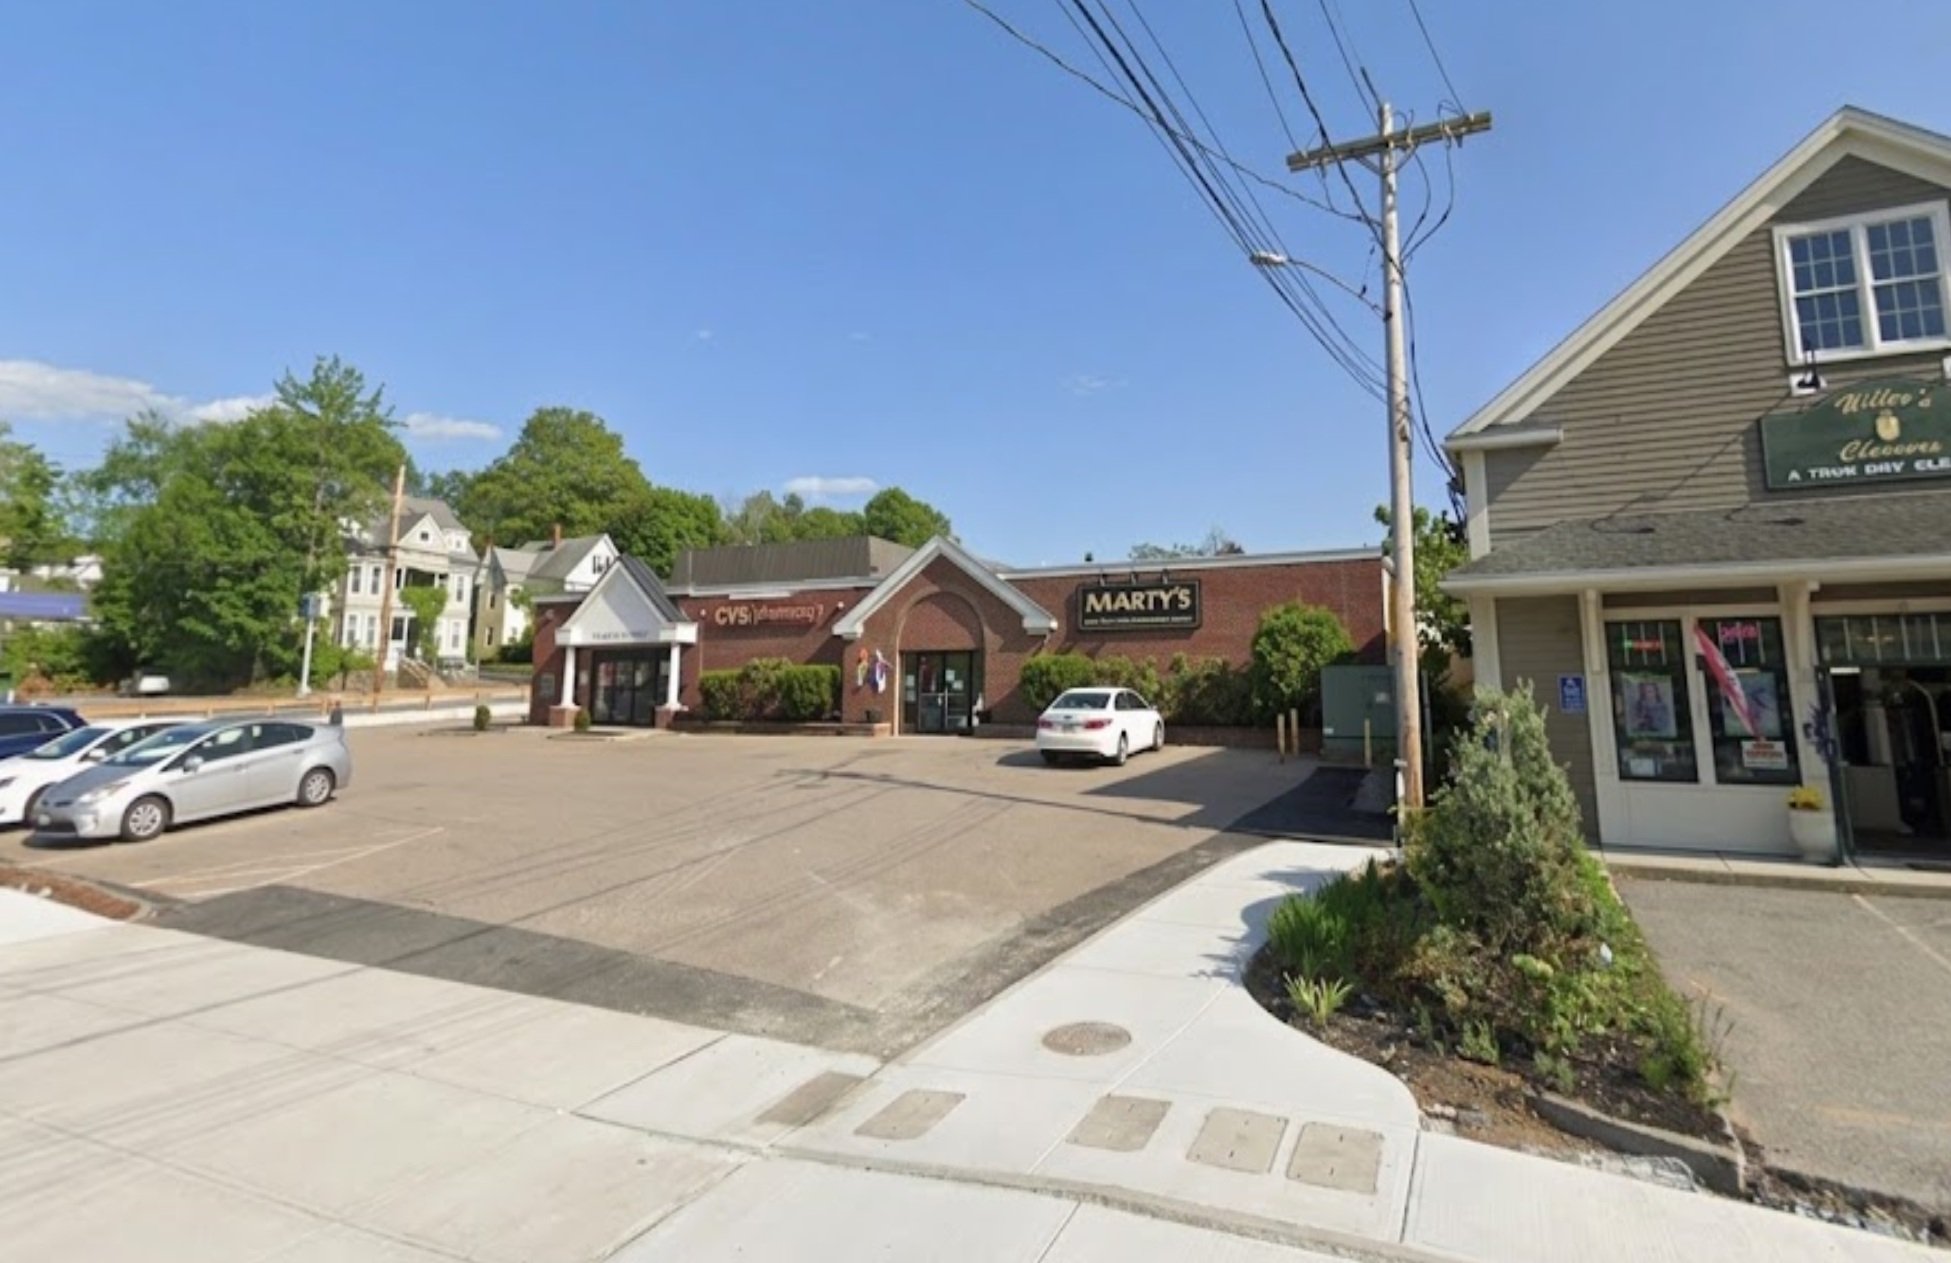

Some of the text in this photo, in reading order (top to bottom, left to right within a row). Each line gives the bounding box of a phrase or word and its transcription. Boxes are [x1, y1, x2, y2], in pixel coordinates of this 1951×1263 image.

[1787, 469, 1802, 481] A
[1863, 461, 1905, 475] DRY
[1085, 586, 1192, 613] MARTY'S
[715, 605, 749, 626] CVS
